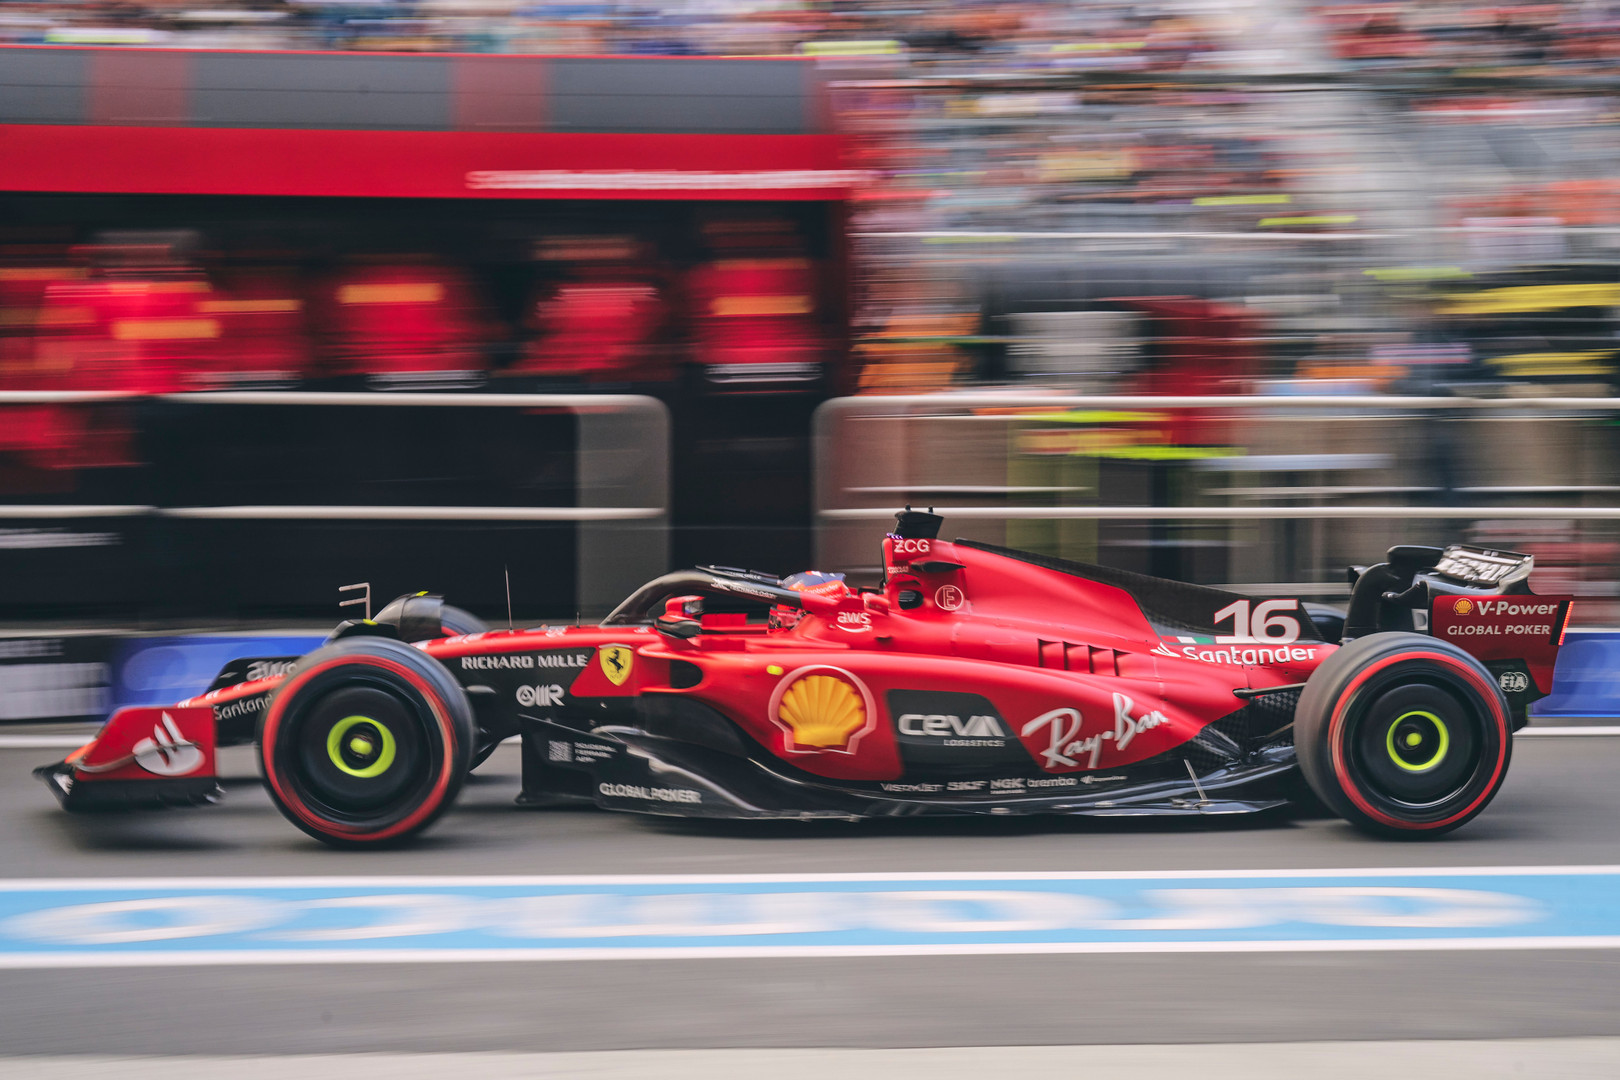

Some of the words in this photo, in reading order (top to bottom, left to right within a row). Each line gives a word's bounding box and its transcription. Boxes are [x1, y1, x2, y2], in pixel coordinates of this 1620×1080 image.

[894, 539, 930, 554] ZCG
[1476, 600, 1557, 616] V-Power
[837, 611, 871, 625] aws
[1214, 599, 1300, 645] 16
[1447, 625, 1501, 635] GLOBAL
[1504, 624, 1550, 635] POKER
[461, 656, 534, 670] RICHARD
[538, 654, 588, 668] MILLE
[1182, 646, 1317, 666] Santander
[1021, 692, 1169, 769] Ray-Ban
[943, 739, 1005, 747] LOGISTICS
[990, 778, 1026, 789] NGK
[1027, 776, 1079, 788] brembo
[599, 783, 652, 800] GLOBAL
[650, 787, 702, 803] POKER
